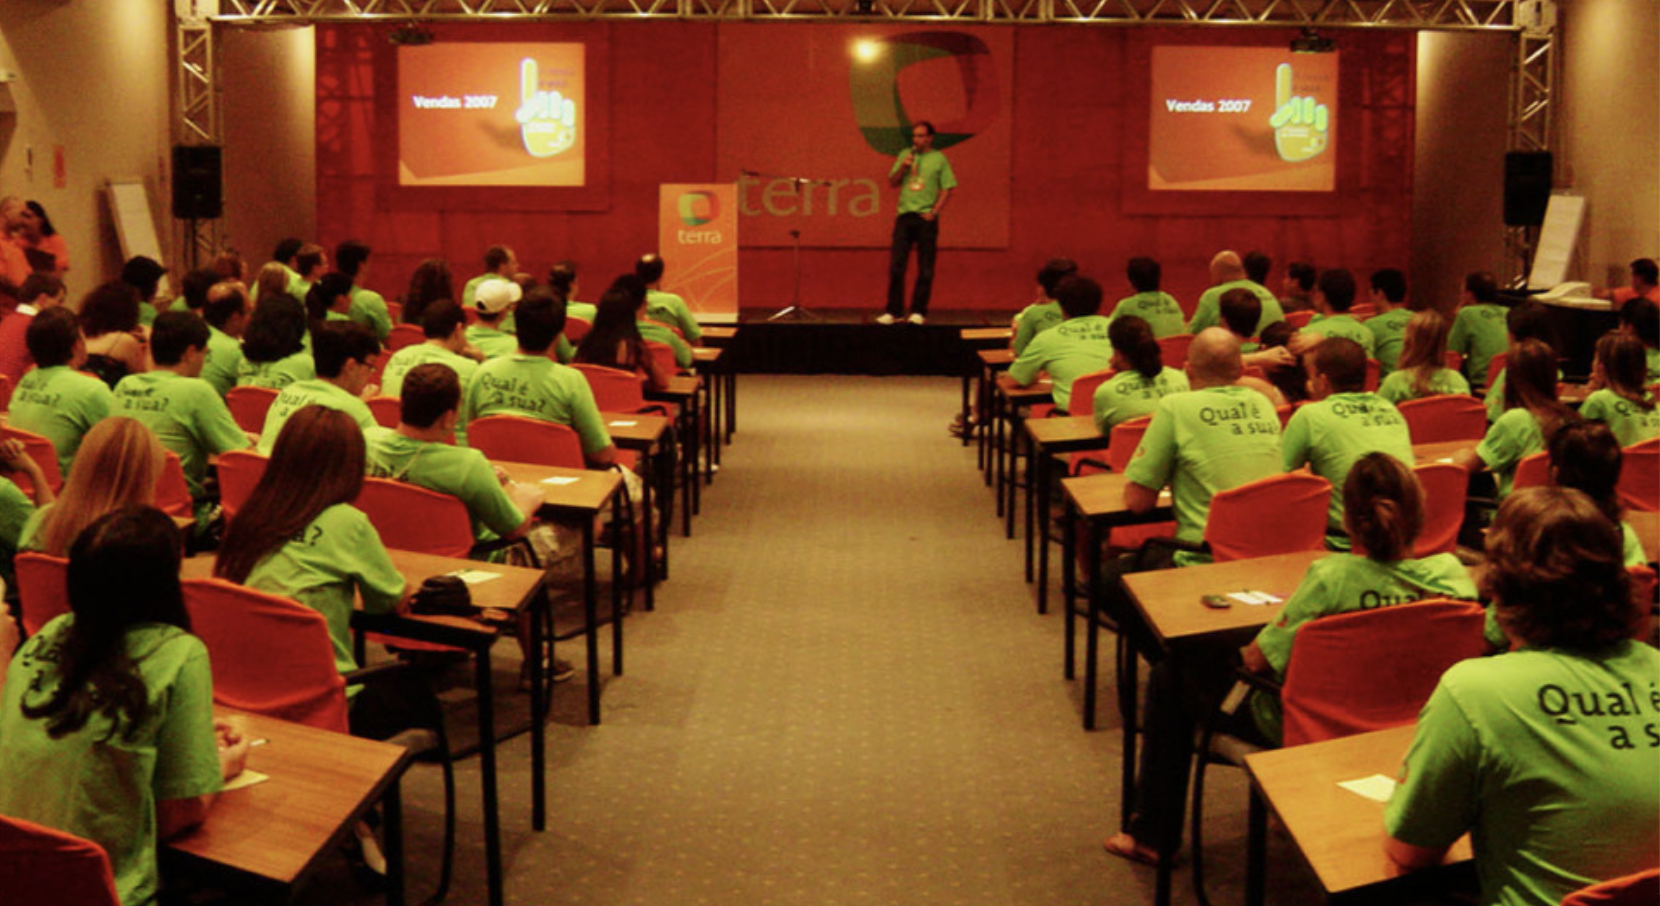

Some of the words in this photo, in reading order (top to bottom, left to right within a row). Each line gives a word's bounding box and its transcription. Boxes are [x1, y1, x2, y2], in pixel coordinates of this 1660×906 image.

[412, 95, 462, 109] Vendas
[463, 95, 498, 109] 2007
[1166, 99, 1214, 113] Vendas
[1217, 99, 1251, 113] 2007
[736, 174, 881, 217] terra
[677, 228, 723, 245] terra
[481, 371, 517, 392] Qual
[508, 395, 547, 413] sua?
[1199, 401, 1248, 427] Qual
[1251, 402, 1262, 420] é
[1231, 422, 1244, 436] a
[1537, 682, 1642, 725] Qual
[1607, 725, 1636, 750] a
